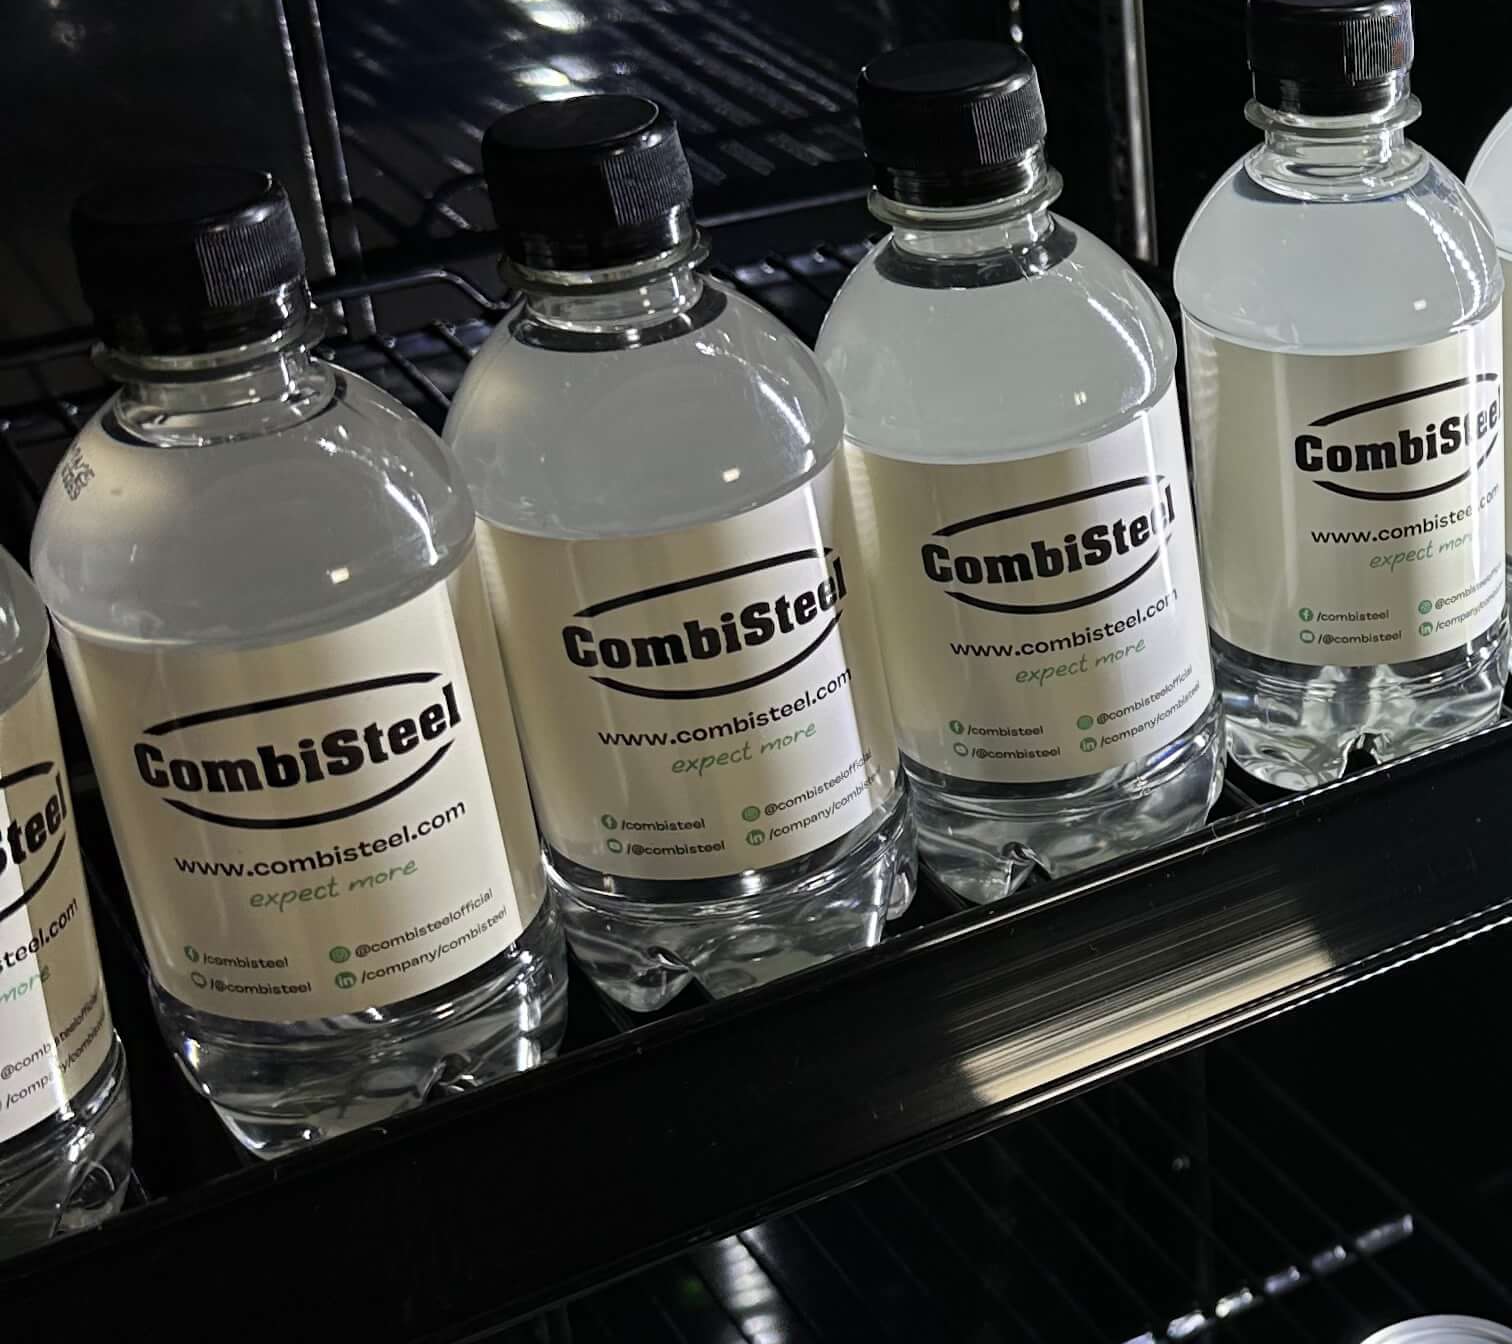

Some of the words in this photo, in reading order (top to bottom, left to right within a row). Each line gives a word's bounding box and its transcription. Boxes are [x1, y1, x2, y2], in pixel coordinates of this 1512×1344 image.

[1311, 483, 1500, 545] www.combistee.com
[1369, 540, 1435, 573] expect
[1438, 531, 1474, 555] mor
[561, 555, 849, 671] CombiSteel
[1316, 609, 1390, 624] /combisteel
[1318, 629, 1403, 645] /@combisteel
[1015, 655, 1089, 687] expect
[1095, 638, 1146, 668] more
[597, 666, 853, 748] www.combisteel.com
[967, 724, 1044, 738] /combisteel
[133, 685, 463, 794] CombiSteel
[671, 740, 754, 777] expect
[760, 721, 818, 756] more
[972, 745, 1062, 760] /@combisteel
[174, 800, 467, 878] www.combisteel.com
[621, 817, 707, 832] /combisteel
[626, 840, 726, 857] /@combisteel
[250, 875, 340, 913] expect
[349, 857, 419, 893] more
[354, 887, 494, 959] @combisteelofficial
[361, 905, 509, 985] /company/combisteel
[203, 951, 290, 970] /combisteel
[210, 979, 313, 996] /@combisteel
